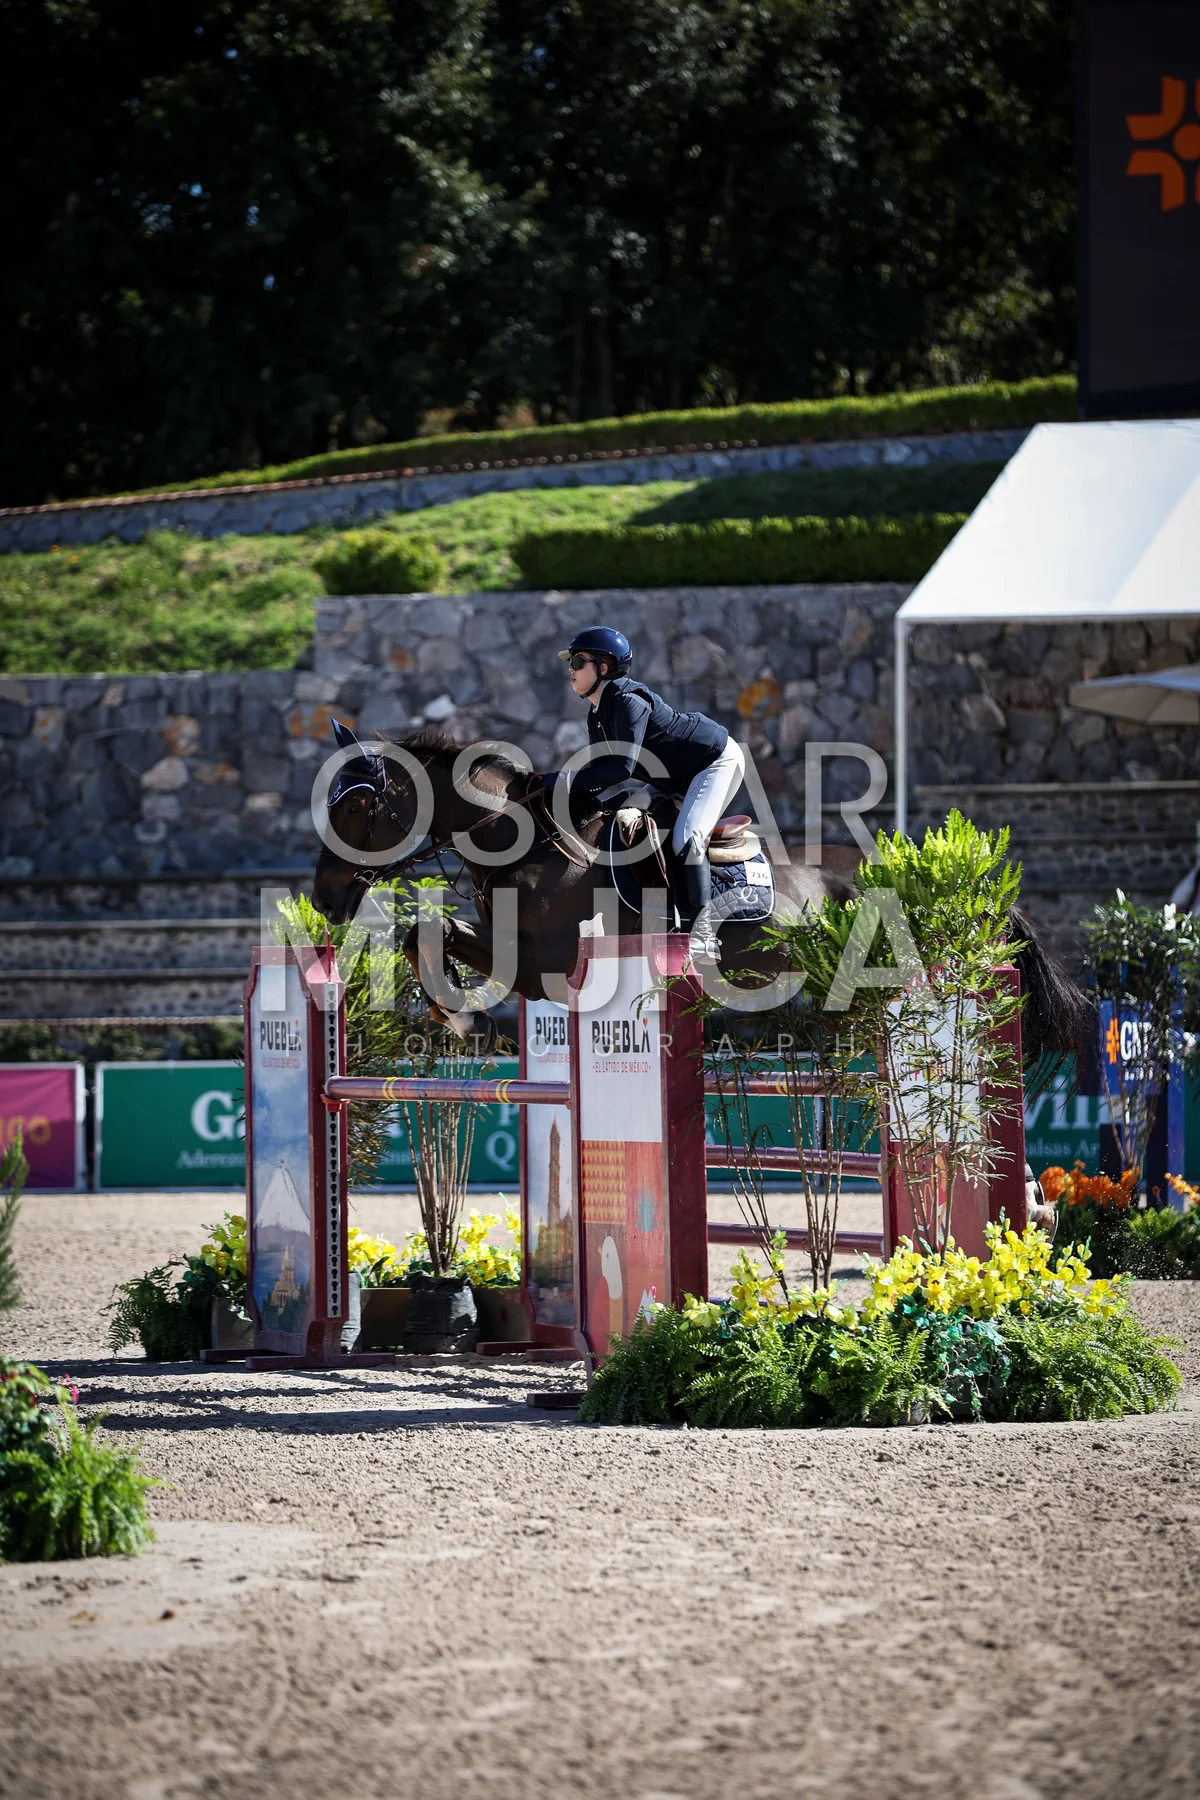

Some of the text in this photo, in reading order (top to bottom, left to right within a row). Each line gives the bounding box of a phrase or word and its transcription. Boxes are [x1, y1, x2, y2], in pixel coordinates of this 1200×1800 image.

[260, 1020, 302, 1051] PUEBLA
[592, 1018, 651, 1054] PUEBLA
[602, 1061, 621, 1073] LATIDO
